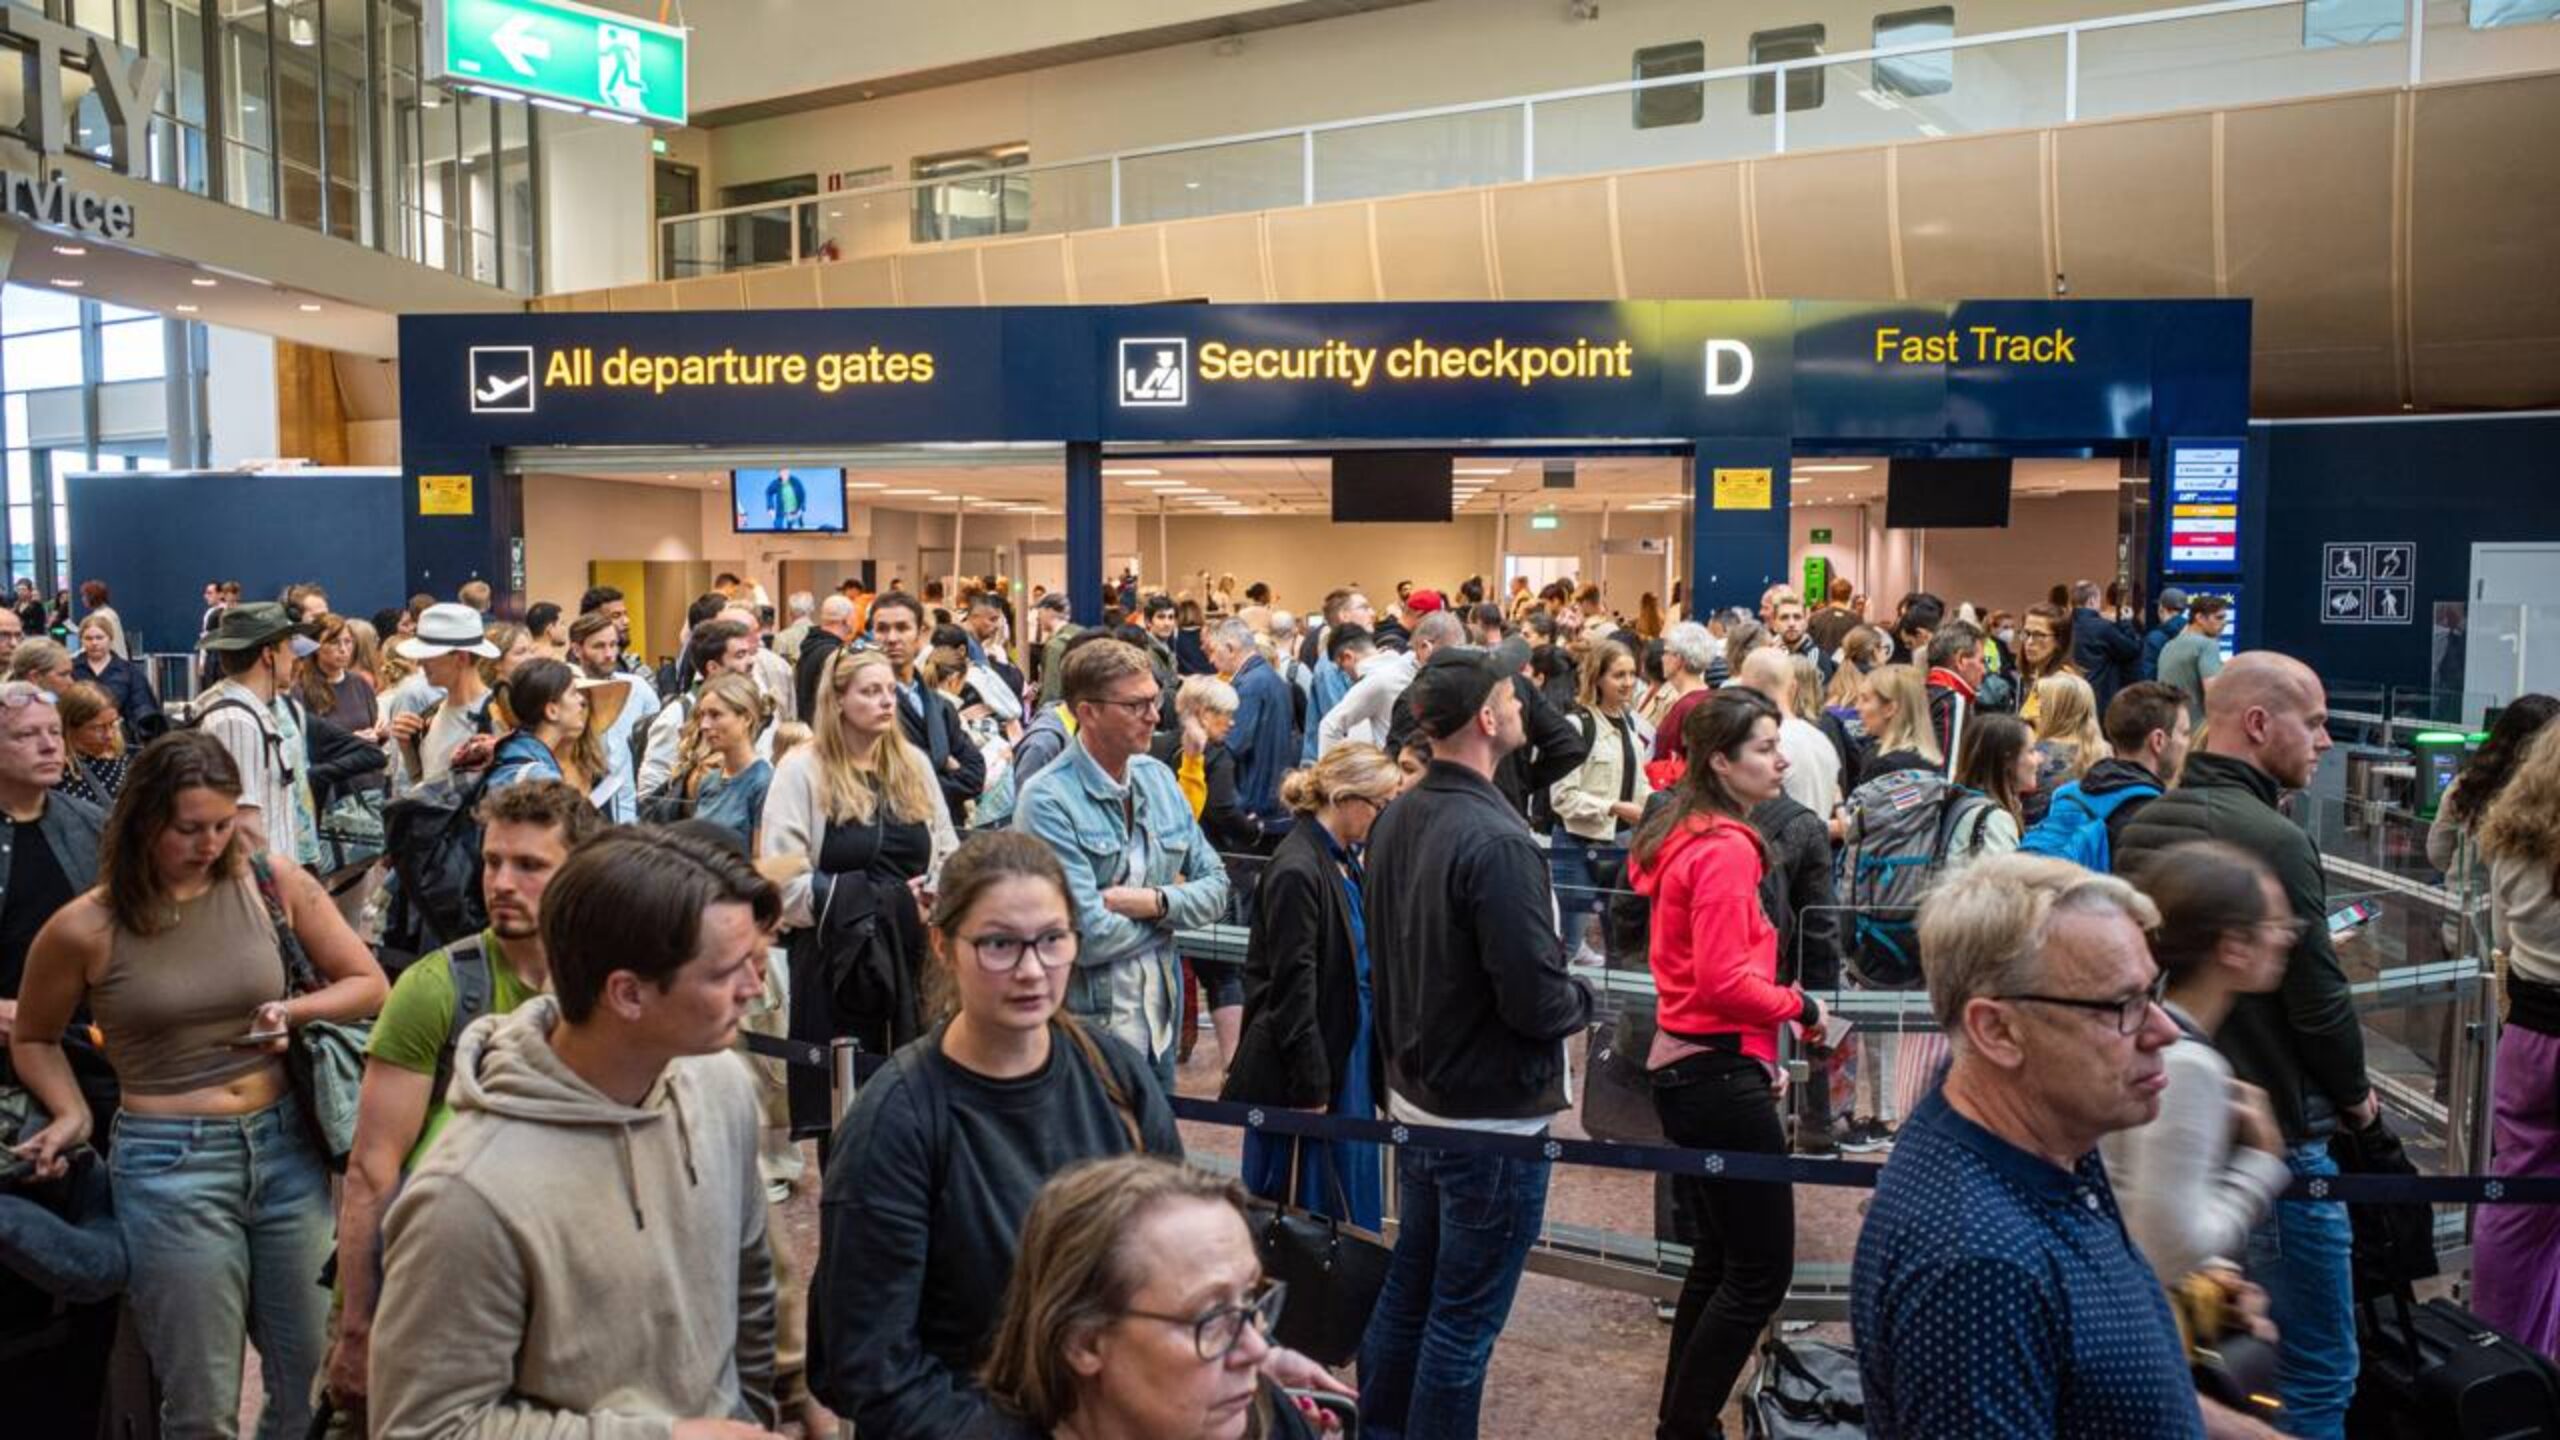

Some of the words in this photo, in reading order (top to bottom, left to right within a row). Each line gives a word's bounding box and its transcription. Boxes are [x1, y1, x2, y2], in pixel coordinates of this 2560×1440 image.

[1199, 339, 1377, 387] Security
[1386, 338, 1633, 386] checkpoint
[1706, 340, 1753, 395] D
[1876, 327, 1959, 363] Fast
[1969, 326, 2075, 362] Track
[544, 348, 593, 387] All
[602, 348, 807, 393] departure
[816, 347, 933, 392] gates
